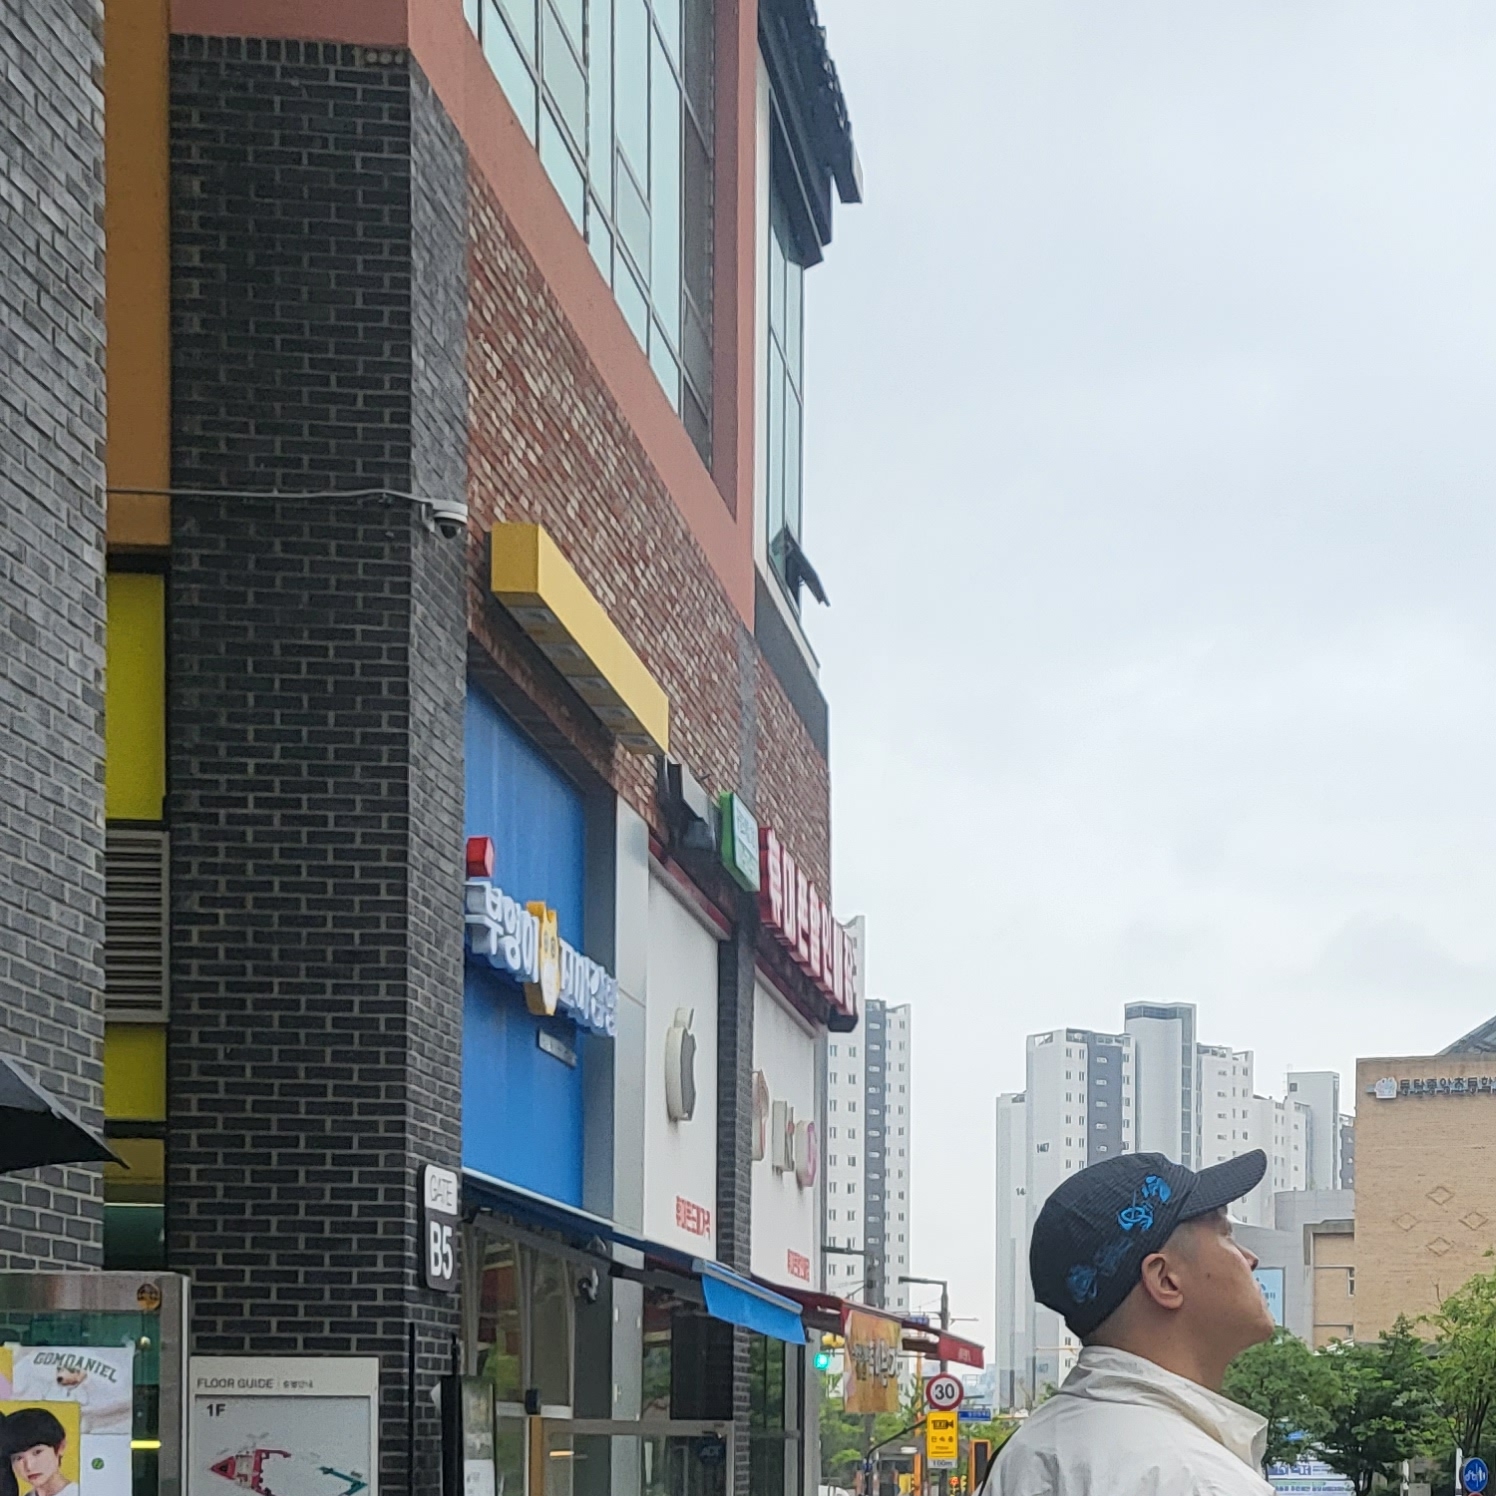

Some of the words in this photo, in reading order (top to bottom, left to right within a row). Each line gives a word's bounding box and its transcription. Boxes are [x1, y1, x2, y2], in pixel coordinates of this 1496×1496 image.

[468, 882, 540, 984] 부엉이
[430, 1174, 453, 1207] GATE
[430, 1220, 454, 1280] B5
[33, 1352, 118, 1384] GOMDANIEL
[197, 1378, 235, 1389] FLOOR
[237, 1378, 275, 1389] GUIDE
[934, 1383, 955, 1400] 30
[206, 1403, 226, 1417] 1F
